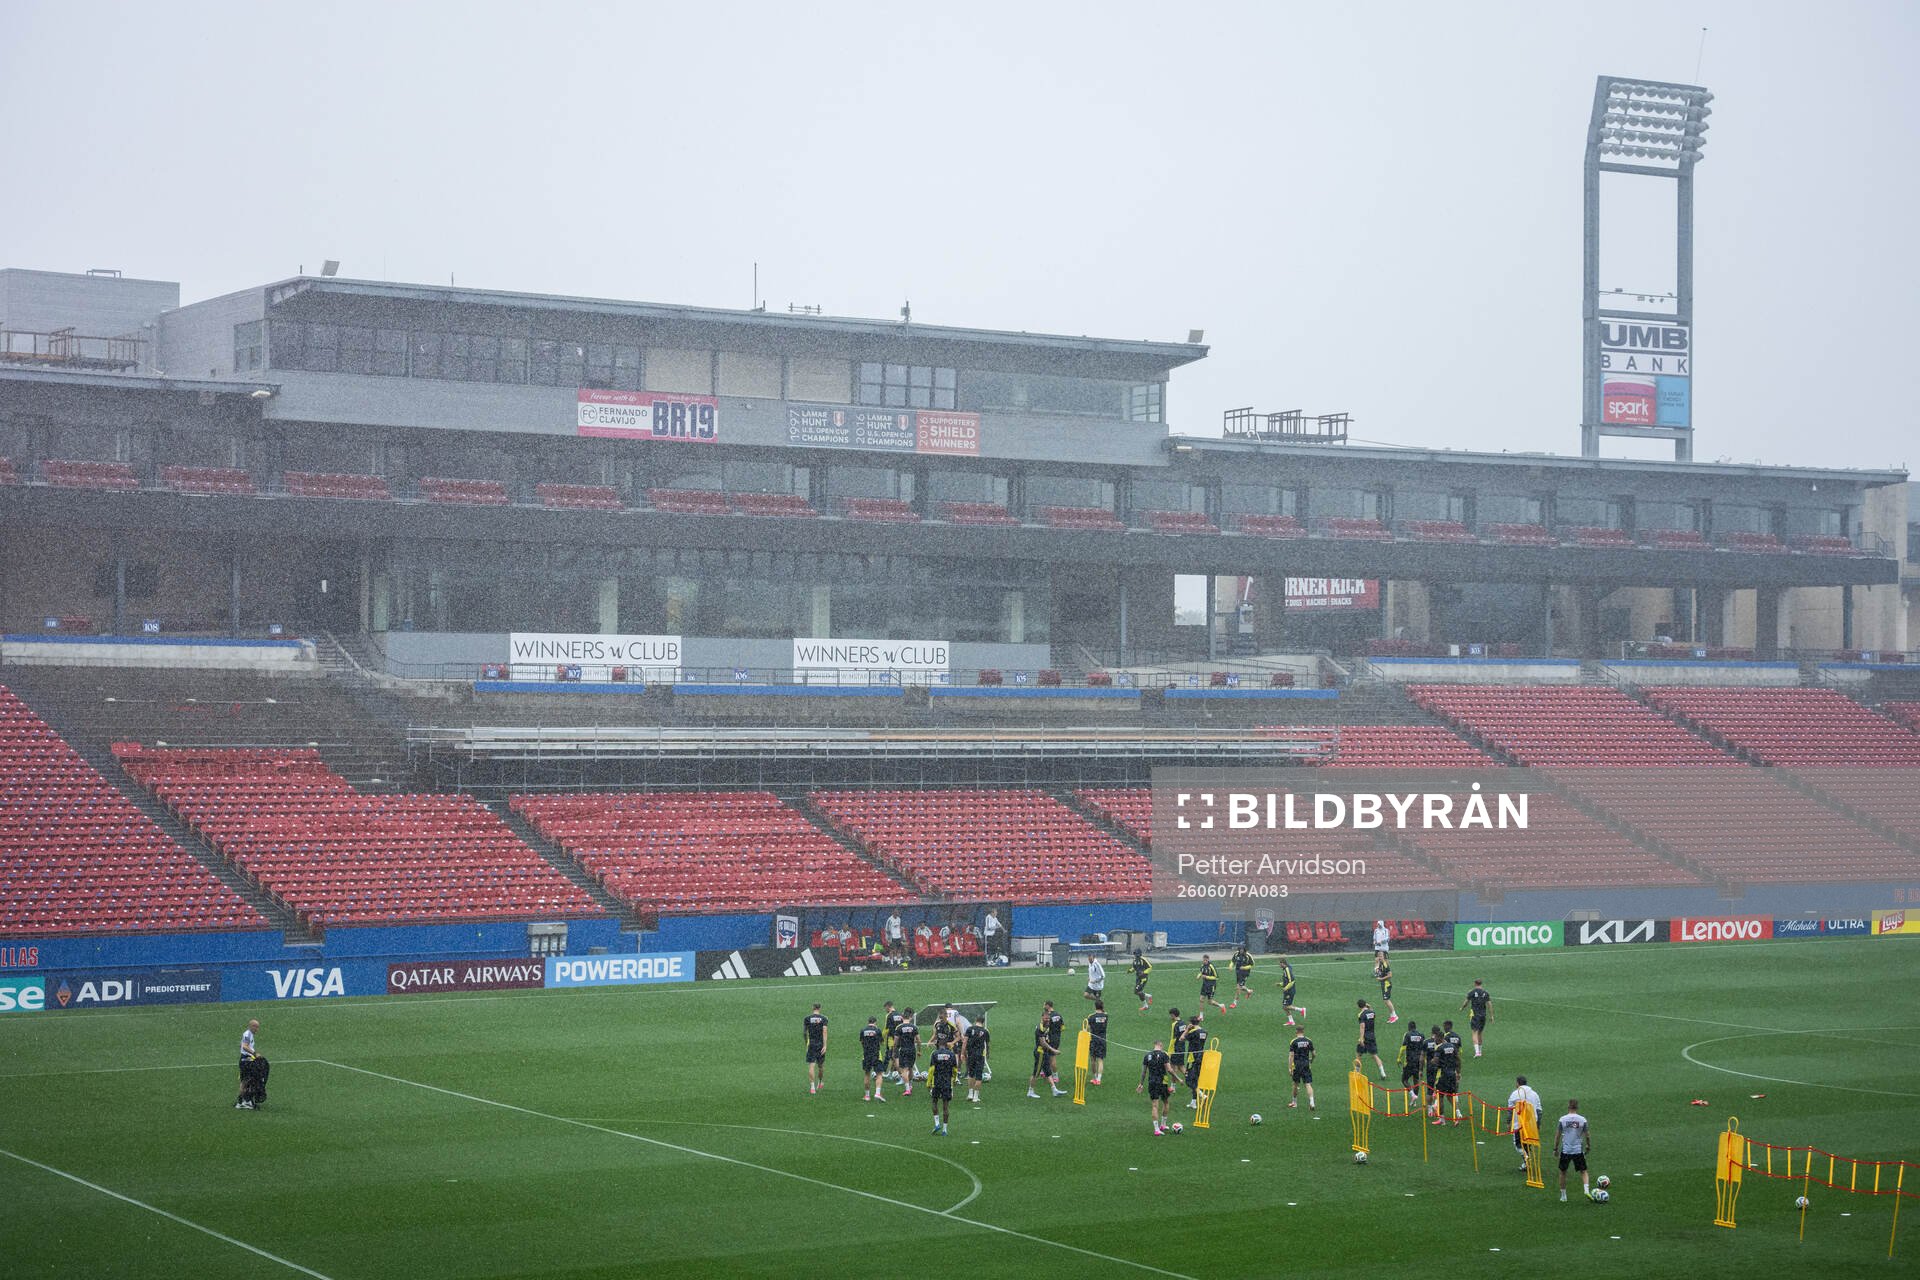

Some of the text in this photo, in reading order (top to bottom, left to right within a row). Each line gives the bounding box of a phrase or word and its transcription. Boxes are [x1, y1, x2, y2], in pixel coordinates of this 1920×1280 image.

[1601, 323, 1688, 350] UMB
[1601, 354, 1688, 374] BANK
[599, 407, 648, 417] FERNANDO
[867, 414, 892, 422] LAMAR
[1609, 398, 1649, 419] spark
[599, 416, 636, 425] CLAVIJO
[652, 400, 714, 440] BR19
[801, 418, 828, 427] HUNT
[856, 413, 866, 444] 2016
[867, 421, 893, 430] HUNT
[801, 435, 849, 444] CHAMPIONS
[919, 416, 929, 447] 2016
[930, 426, 976, 439] SHIELD
[867, 438, 914, 447] CHAMPIONS
[930, 439, 976, 449] WINNERS
[514, 640, 605, 659] WINNERS
[628, 641, 678, 661] CLUB
[797, 645, 879, 664] WINNERS
[900, 647, 946, 665] CLUB
[1681, 917, 1762, 941] Lenovo
[1779, 918, 1865, 932] Michelob ULTRA
[1466, 924, 1553, 947] aramco
[391, 964, 542, 990] QATAR AIRWAYS
[555, 957, 682, 982] POWERADE
[76, 979, 211, 1002] ADI PREDICTSTREET
[266, 968, 345, 998] VISA
